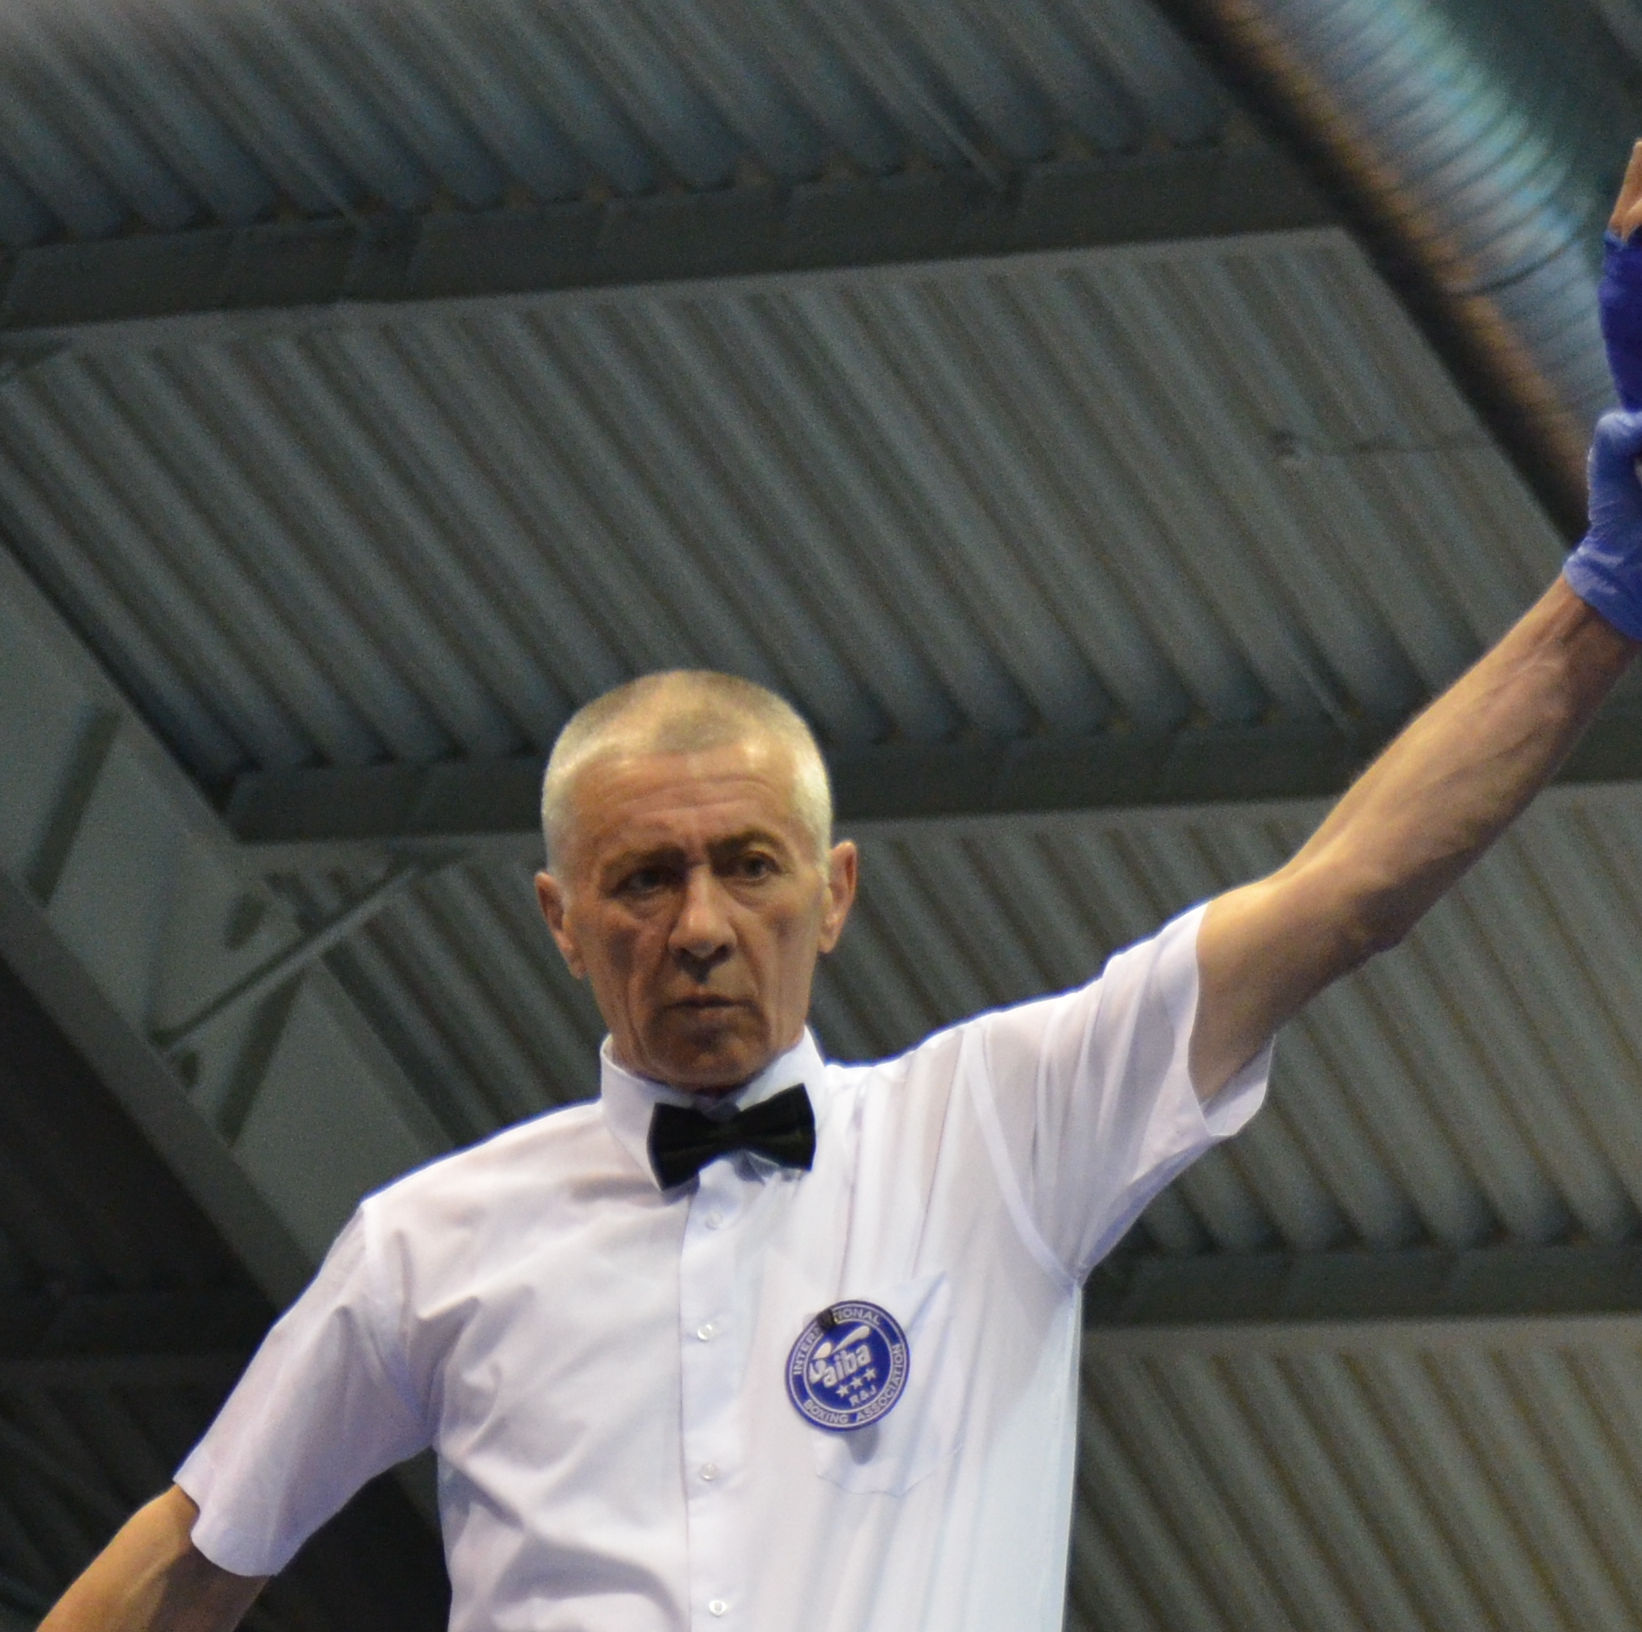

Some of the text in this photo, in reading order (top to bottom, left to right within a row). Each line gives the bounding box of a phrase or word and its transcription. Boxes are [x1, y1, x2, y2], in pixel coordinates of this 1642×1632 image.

[793, 1308, 880, 1376] INTERNTIONAL
[823, 1345, 871, 1387] aiba
[803, 1344, 902, 1424] BOXING ASSOCIATION
[849, 1386, 878, 1406] R&J
